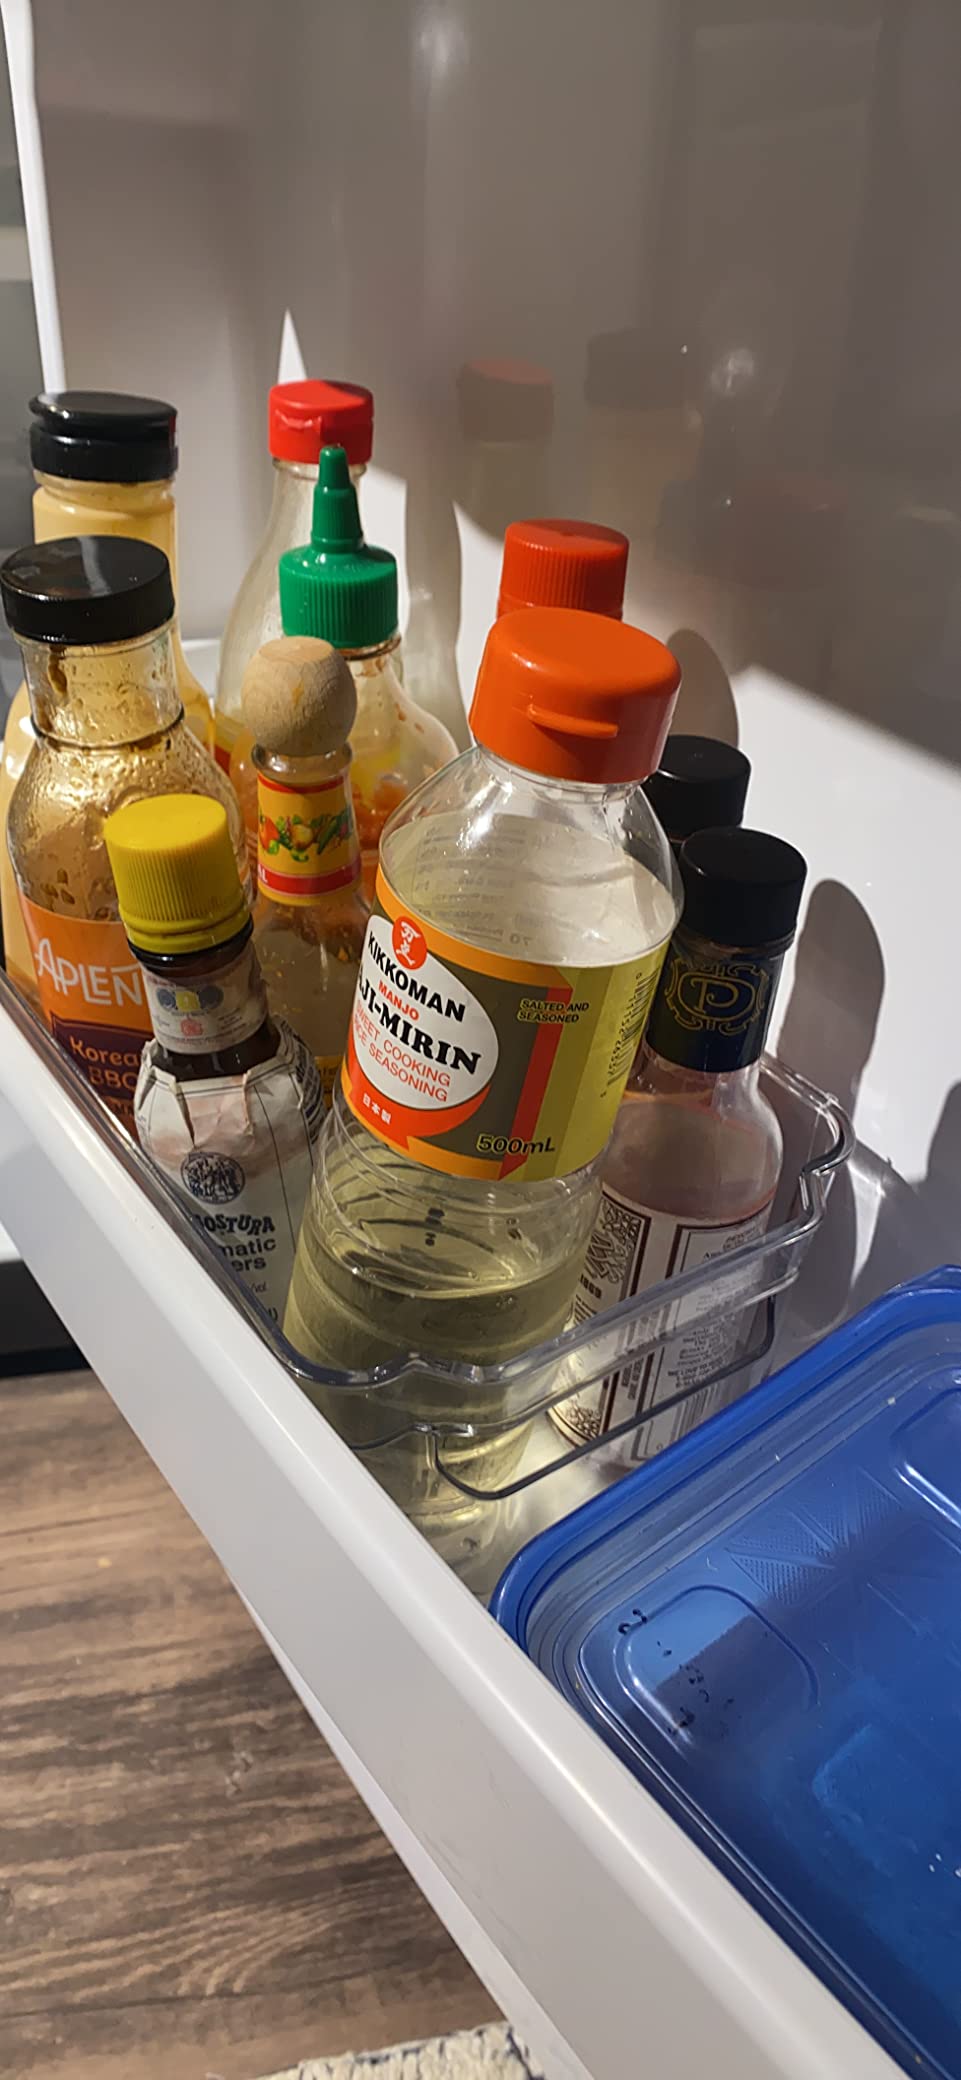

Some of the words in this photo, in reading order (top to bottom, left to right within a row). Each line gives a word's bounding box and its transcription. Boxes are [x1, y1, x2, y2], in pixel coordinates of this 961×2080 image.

[368, 930, 466, 1023] KIKKOMAN
[378, 980, 420, 1021] MANJO
[522, 1000, 565, 1012] SALTED
[567, 1002, 590, 1012] AND
[518, 1010, 580, 1023] SEASONED
[69, 1035, 141, 1066] Korea
[383, 1039, 451, 1087] COOKING
[368, 1043, 448, 1102] SEASONING
[478, 1134, 556, 1154] 500mL
[231, 1257, 267, 1272] ers
